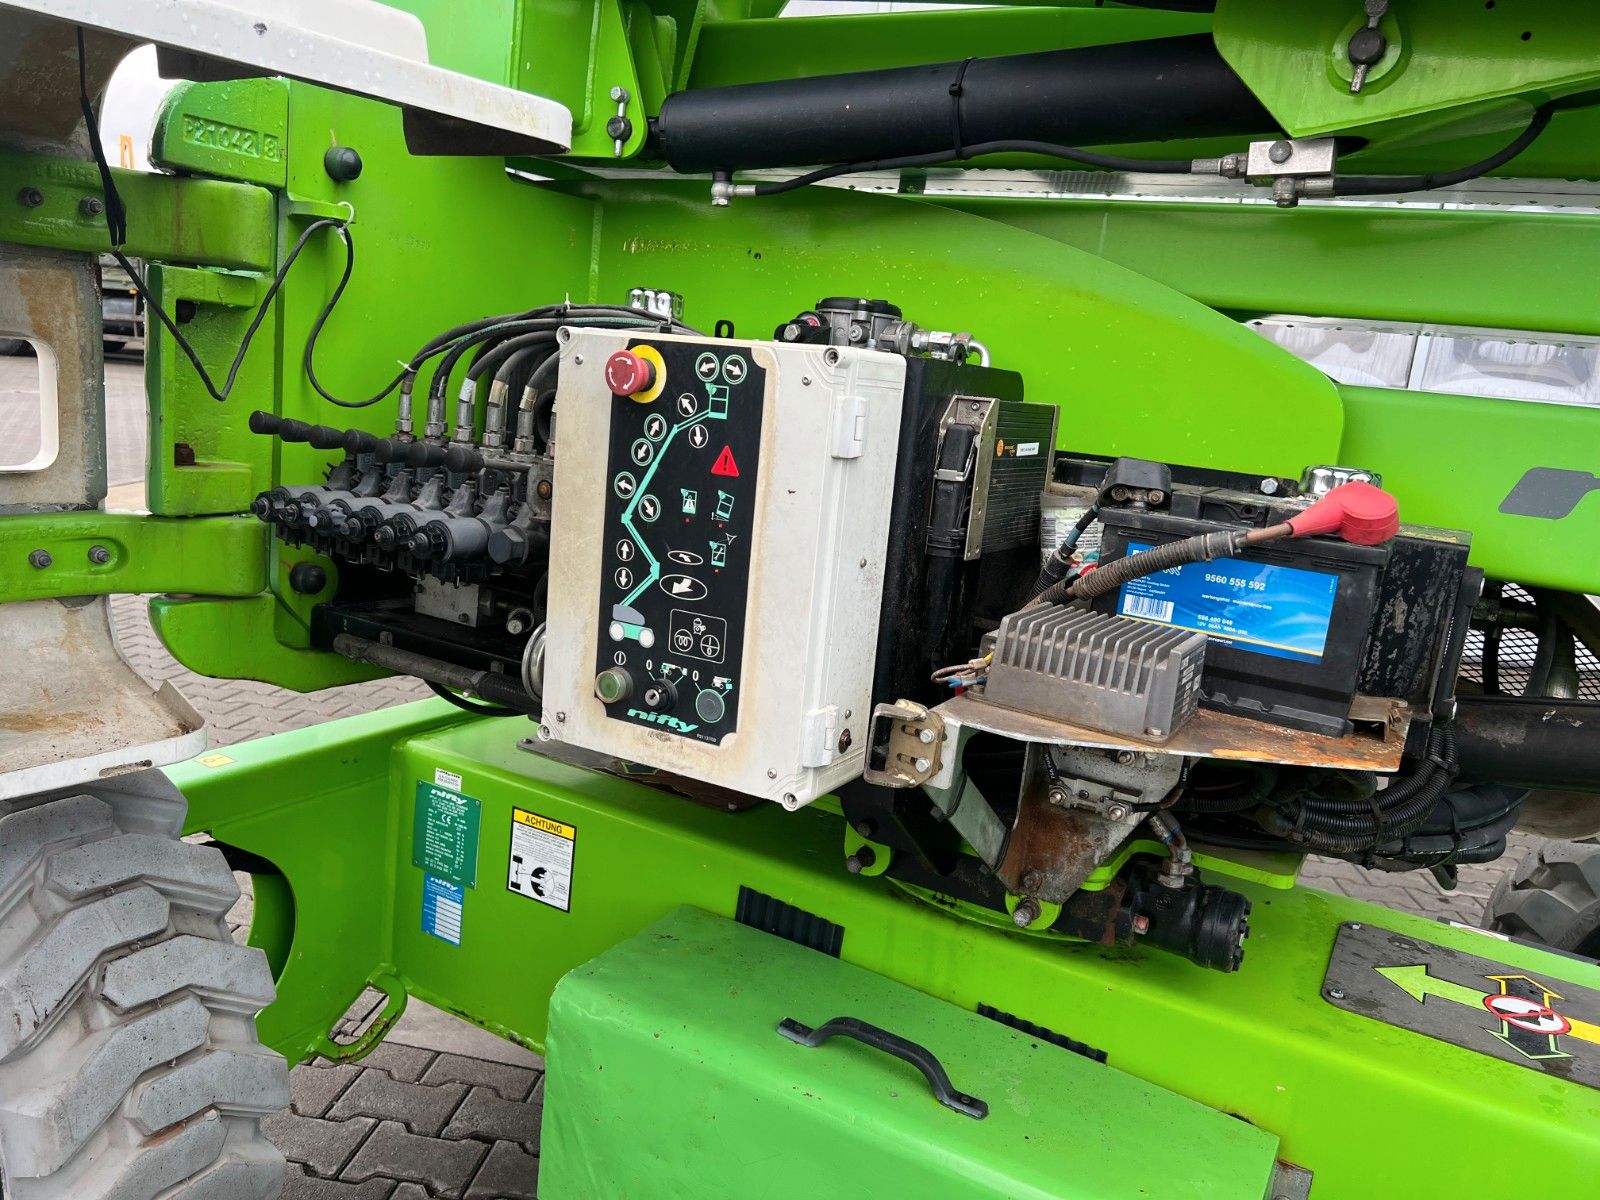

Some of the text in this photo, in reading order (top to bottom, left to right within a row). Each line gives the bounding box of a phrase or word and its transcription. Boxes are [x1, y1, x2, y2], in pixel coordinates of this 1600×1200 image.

[1204, 573, 1266, 591] 9560 555 592
[627, 708, 699, 732] nifty
[430, 788, 468, 805] nifty
[525, 814, 563, 834] ACHTUNG
[429, 876, 459, 891] nifty
